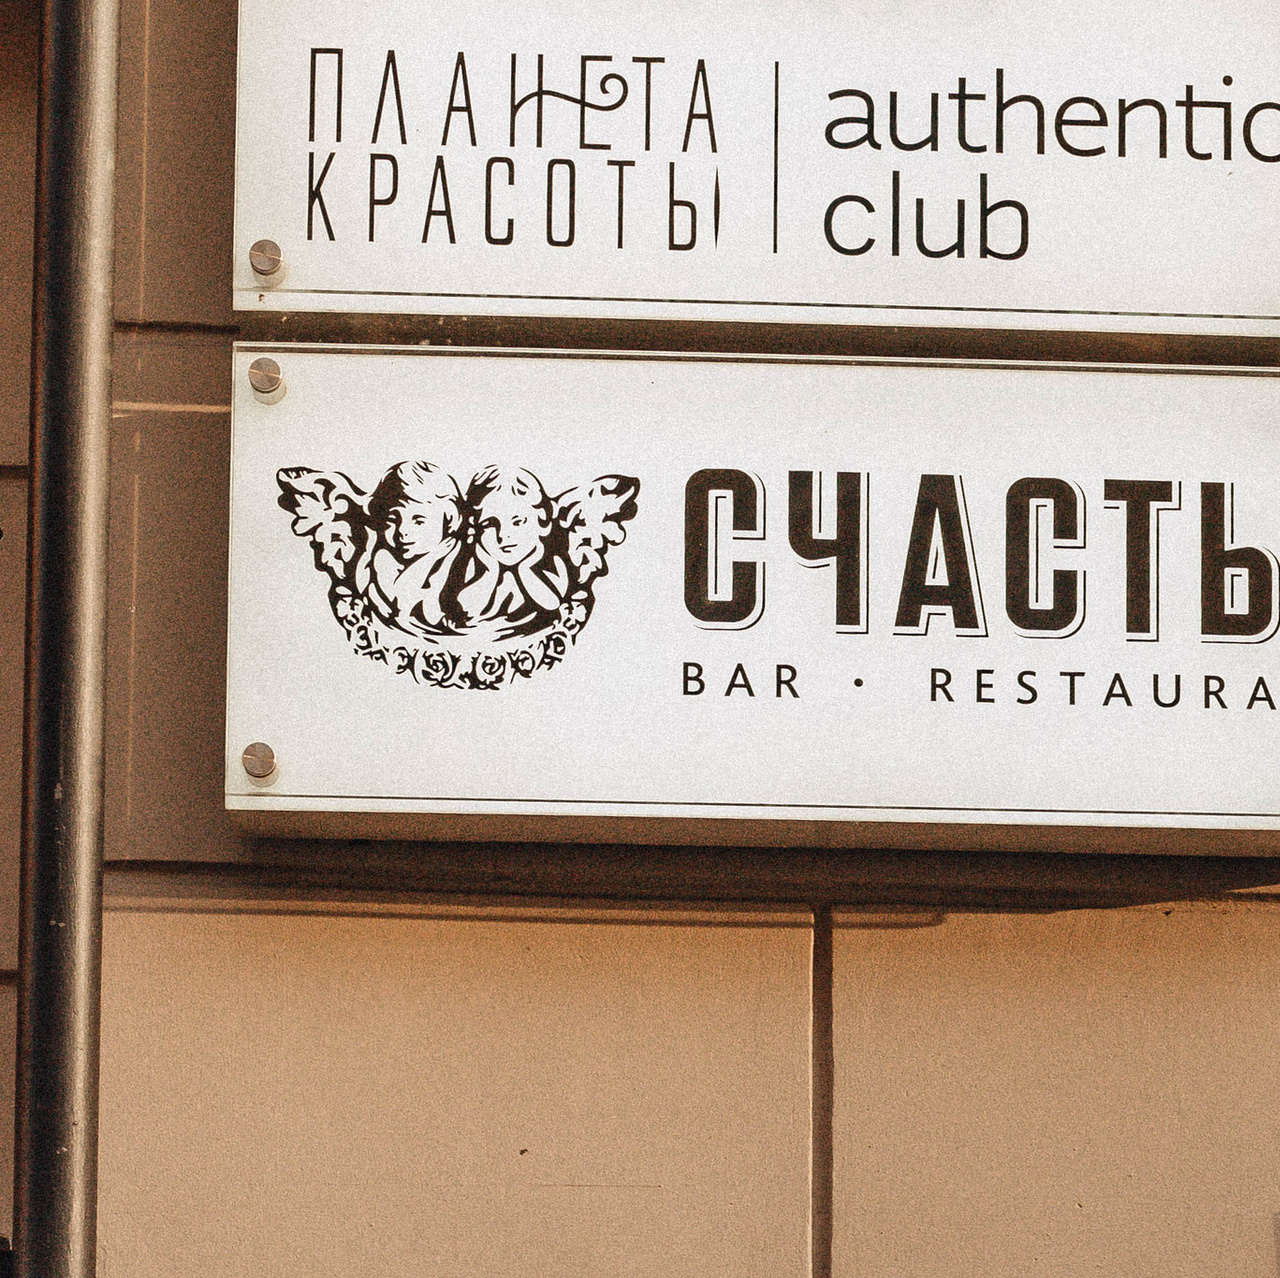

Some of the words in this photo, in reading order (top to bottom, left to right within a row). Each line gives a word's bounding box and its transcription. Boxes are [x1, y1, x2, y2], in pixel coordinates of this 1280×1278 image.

[309, 48, 717, 153] ПЛАНЕТА
[307, 152, 720, 251] КРАСОТЫ
[824, 170, 1029, 260] club
[683, 662, 801, 699] BAR
